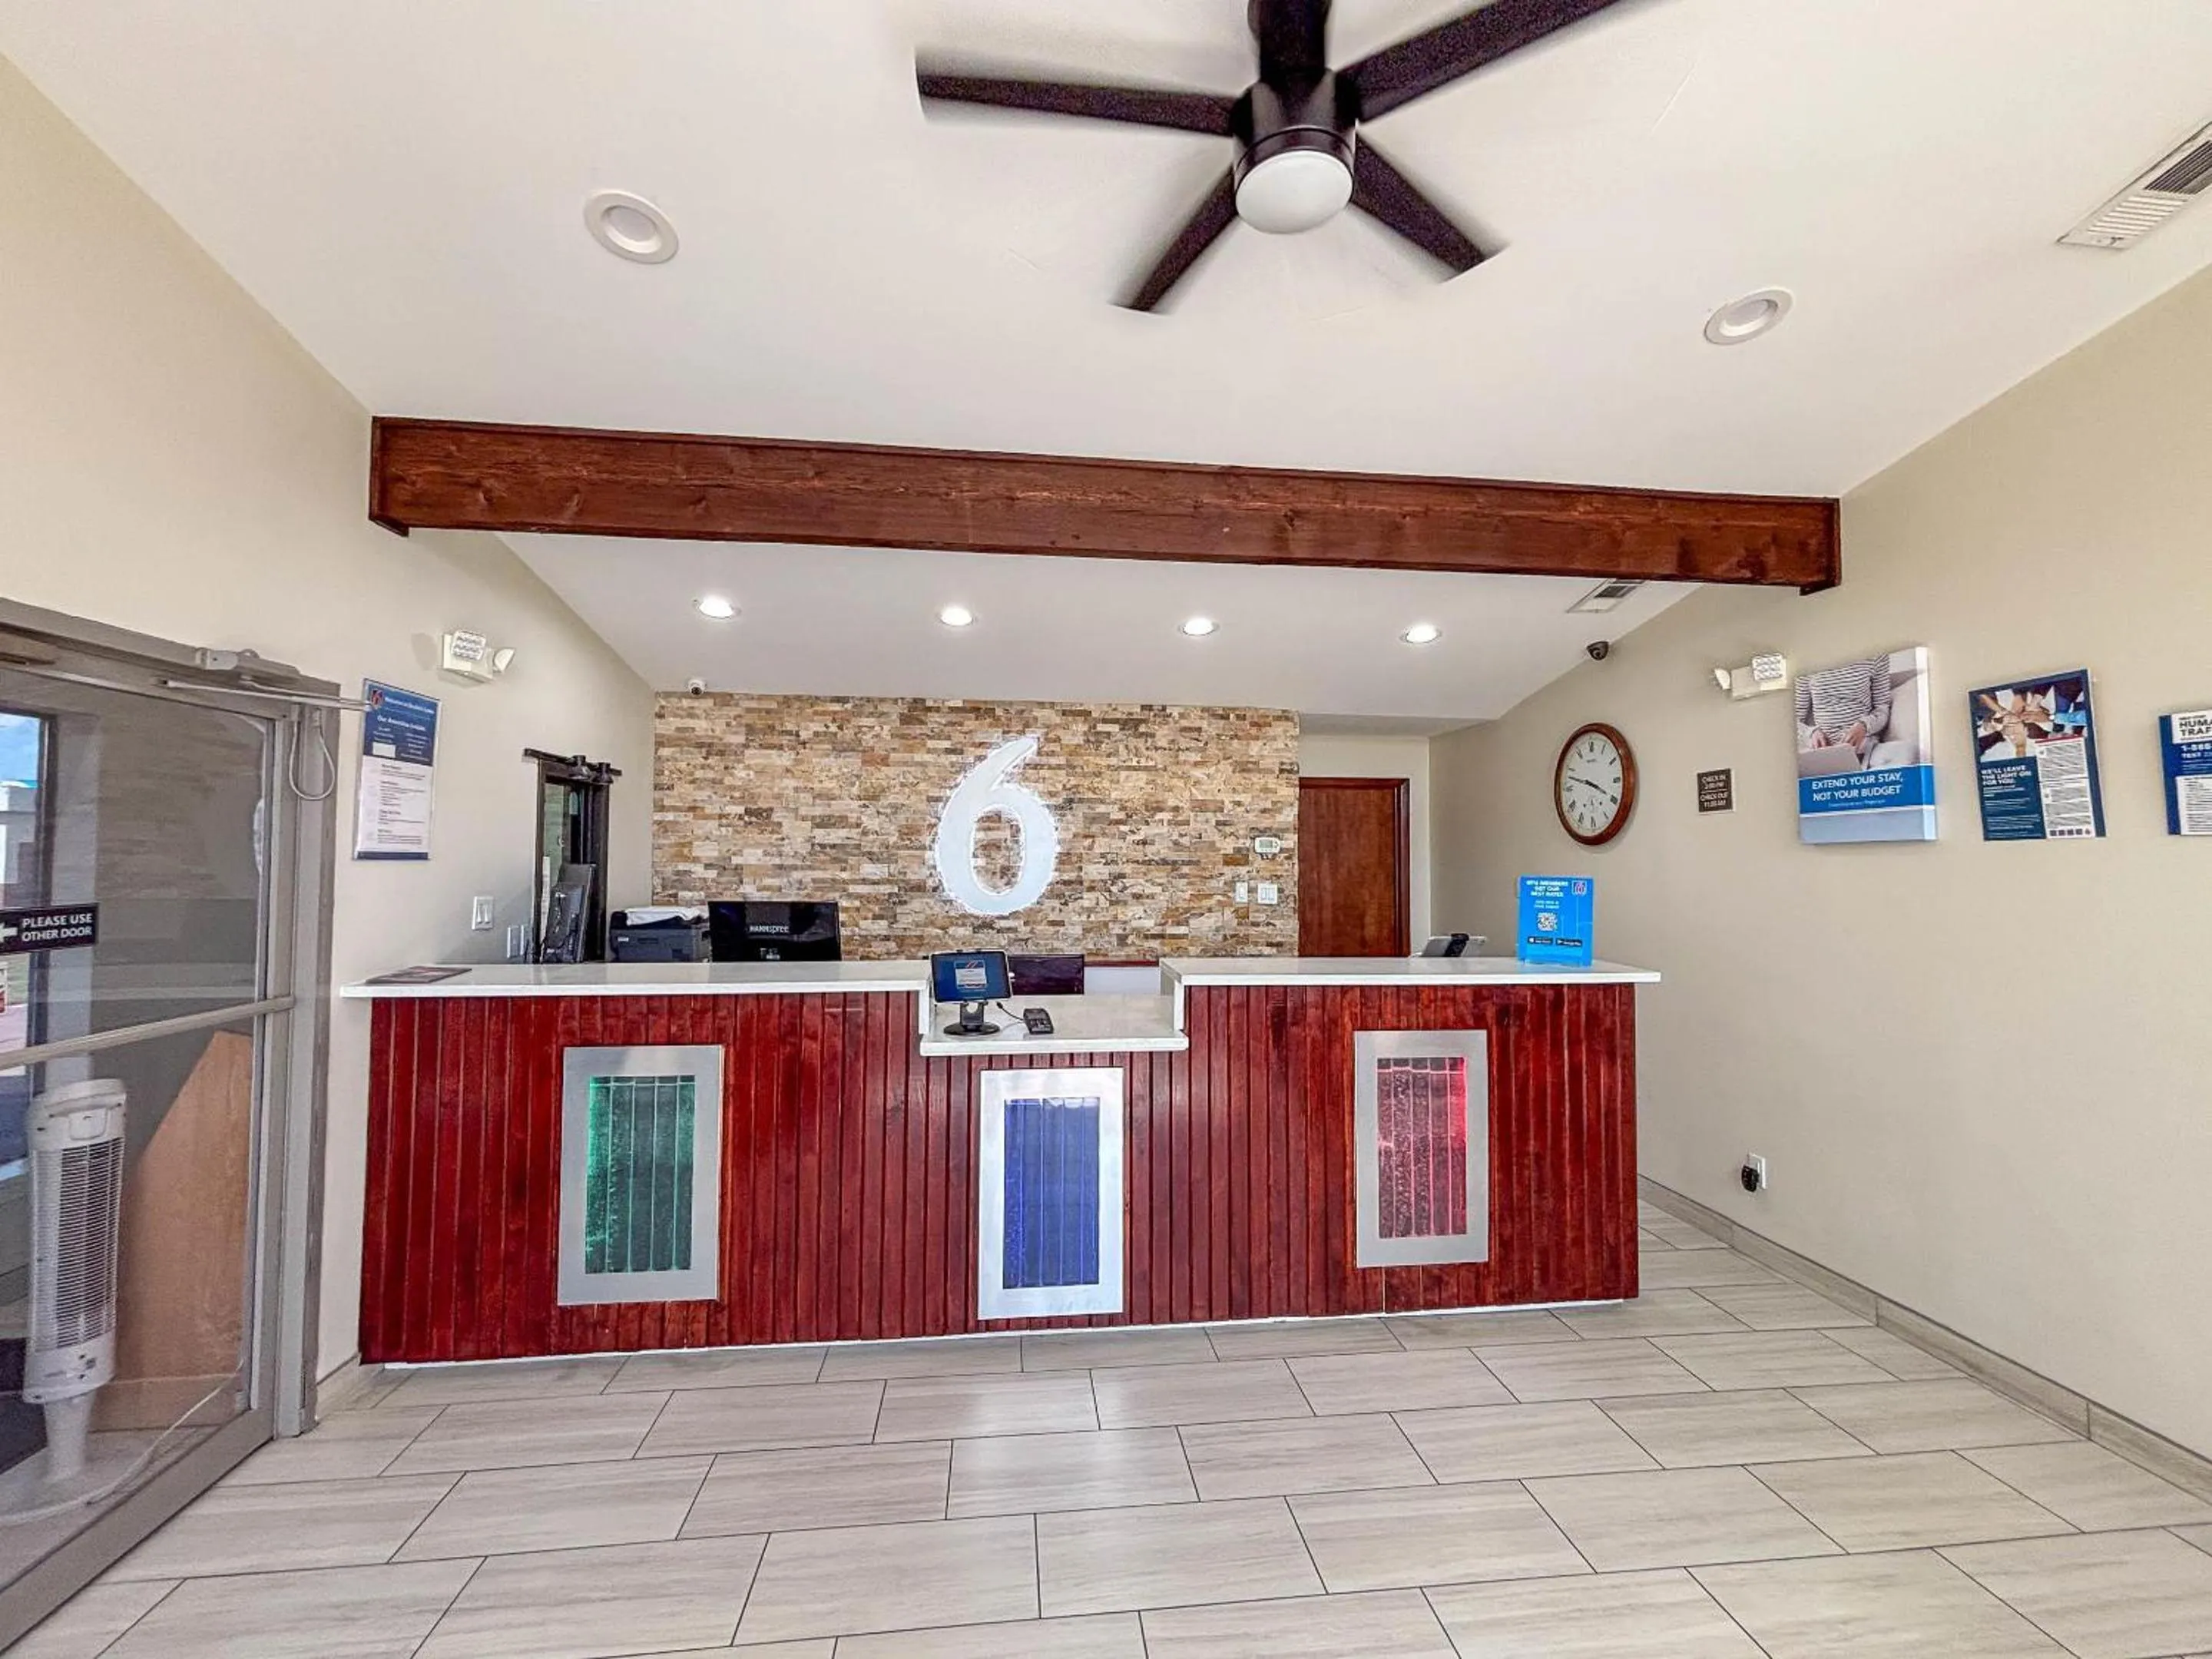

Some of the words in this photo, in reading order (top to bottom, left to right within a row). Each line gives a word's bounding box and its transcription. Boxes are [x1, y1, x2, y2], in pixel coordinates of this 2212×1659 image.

[1812, 778, 1847, 790] EXTEND
[1849, 775, 1876, 786] YOUR
[1877, 771, 1903, 783] STAY,
[1813, 792, 1833, 802] NOT
[1833, 789, 1859, 800] YOUR
[1860, 785, 1902, 798] BUDGET
[934, 735, 1060, 916] 6
[22, 915, 68, 928] PLEASE
[70, 913, 93, 924] USE
[22, 929, 59, 942] OTHER
[60, 926, 93, 939] DOOR
